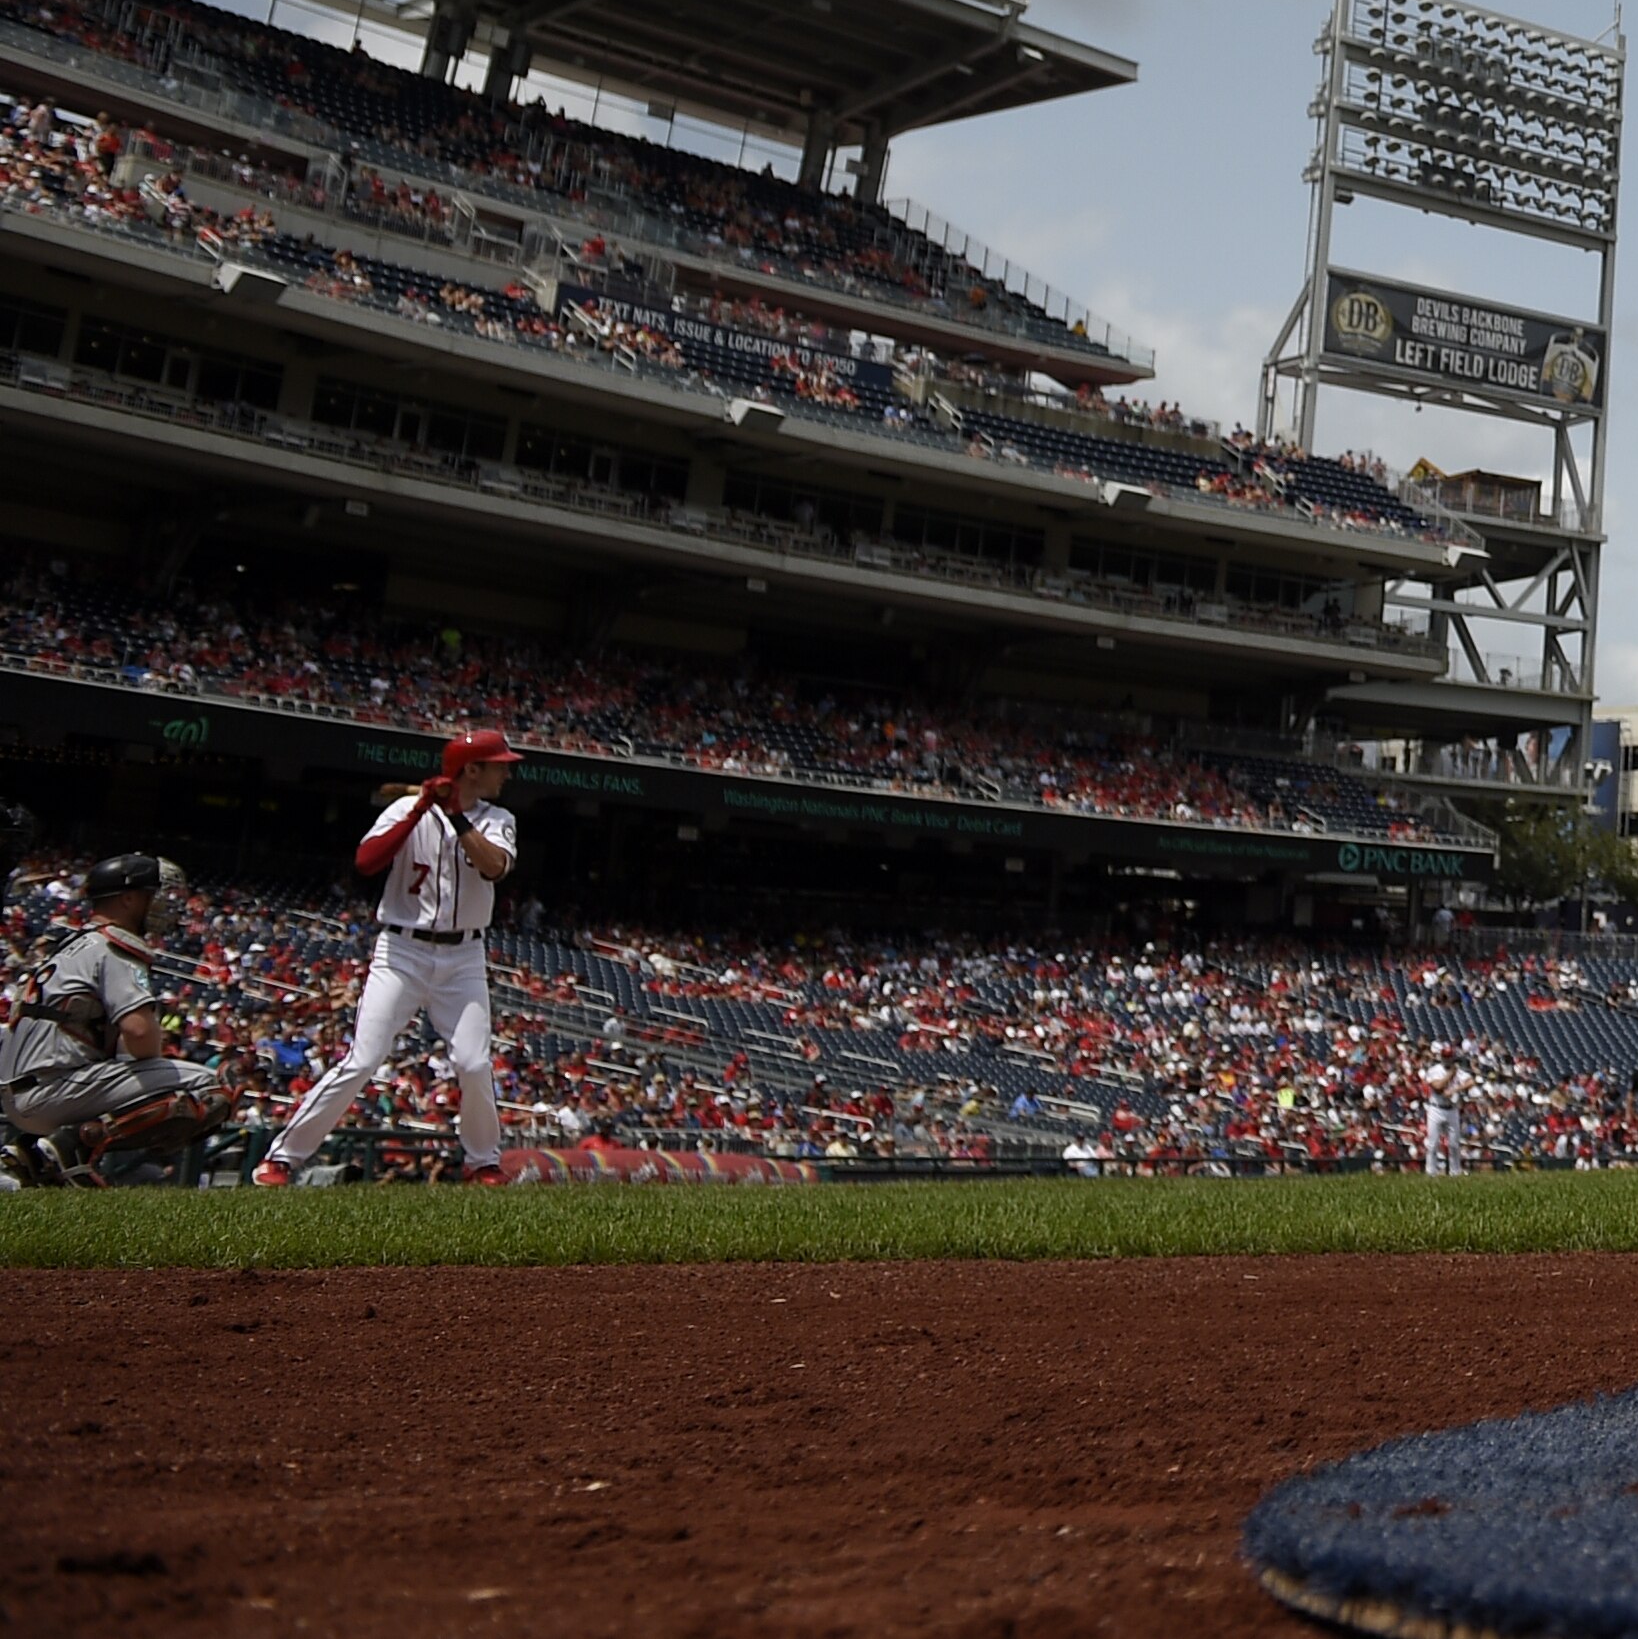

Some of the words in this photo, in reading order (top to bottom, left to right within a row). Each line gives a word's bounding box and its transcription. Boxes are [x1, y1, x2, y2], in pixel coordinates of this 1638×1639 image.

[632, 303, 670, 334] NATS,
[674, 318, 712, 343] ISSUE
[713, 330, 724, 346] &
[727, 331, 797, 361] LOCATION
[1349, 298, 1379, 332] DB
[1417, 297, 1459, 323] DEVILS
[1462, 305, 1525, 338] BACKBONE
[1411, 316, 1467, 345] BREWING
[1469, 327, 1527, 356] COMPANY
[1395, 338, 1435, 369] LEFT
[1440, 347, 1484, 379] FIELD
[1488, 357, 1539, 391] LODGE
[355, 744, 386, 762] THE
[516, 764, 600, 791] NATIONALS
[1362, 846, 1408, 874] PNC
[1410, 850, 1465, 877] BANK
[408, 863, 430, 895] 7
